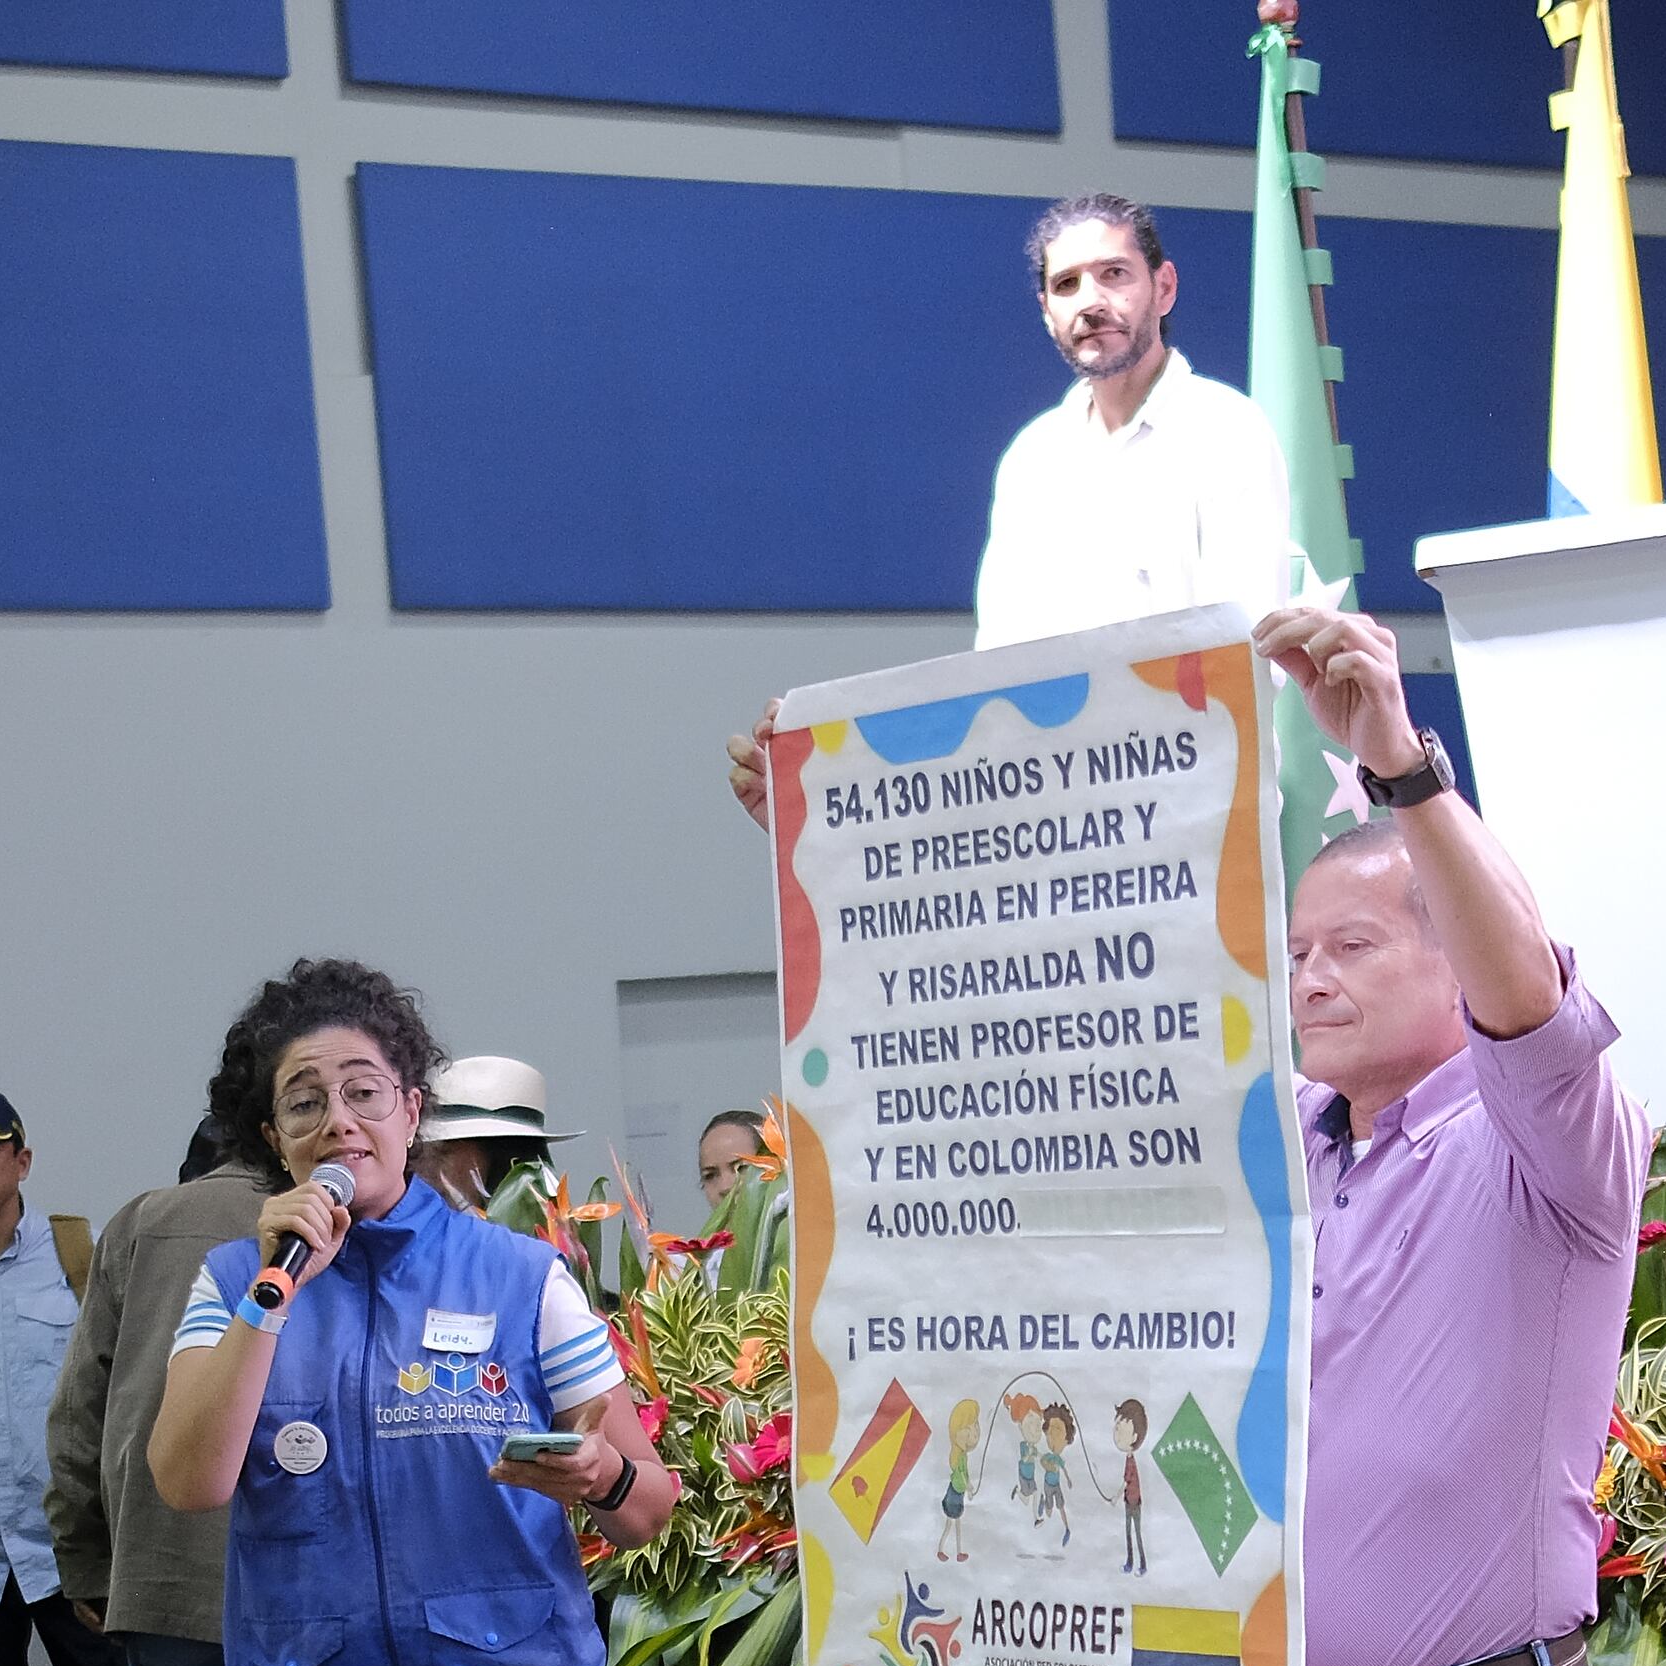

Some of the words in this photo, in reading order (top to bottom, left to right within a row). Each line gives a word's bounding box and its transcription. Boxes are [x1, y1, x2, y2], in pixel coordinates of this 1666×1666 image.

[825, 772, 931, 829] 54.130
[940, 757, 1044, 809] NIÑOS
[1052, 752, 1075, 790] Y
[1087, 730, 1198, 785] NIÑAS
[864, 842, 903, 882] DE
[912, 808, 1125, 874] PREESCOLAR
[1134, 801, 1157, 841] Y
[840, 889, 987, 943] PRIMARIA
[996, 882, 1038, 923] EN
[1050, 860, 1198, 917] PEREIRA
[879, 970, 899, 1007] Y
[909, 949, 1086, 1004] RISARALDA
[1095, 931, 1155, 983] NO
[850, 1025, 960, 1070] TIENEN
[971, 1007, 1143, 1059] PROFESOR
[1153, 1001, 1200, 1042] DE
[876, 1068, 1059, 1126] EDUCACIÓN
[1069, 1062, 1180, 1111] FÍSICA
[864, 1147, 885, 1182] Y
[895, 1143, 936, 1181] EN
[947, 1132, 1119, 1177] COLOMBIA
[1128, 1126, 1202, 1168] SON
[867, 1316, 906, 1353] ES
[916, 1315, 1009, 1351] HORA
[1019, 1313, 1080, 1352] DEL
[1090, 1311, 1236, 1350] CAMBIO!
[375, 1402, 420, 1424] todos
[424, 1404, 434, 1420] a
[438, 1402, 507, 1423] aprender
[512, 1402, 530, 1423] 2.0
[971, 1597, 1125, 1655] ARCOPREF
